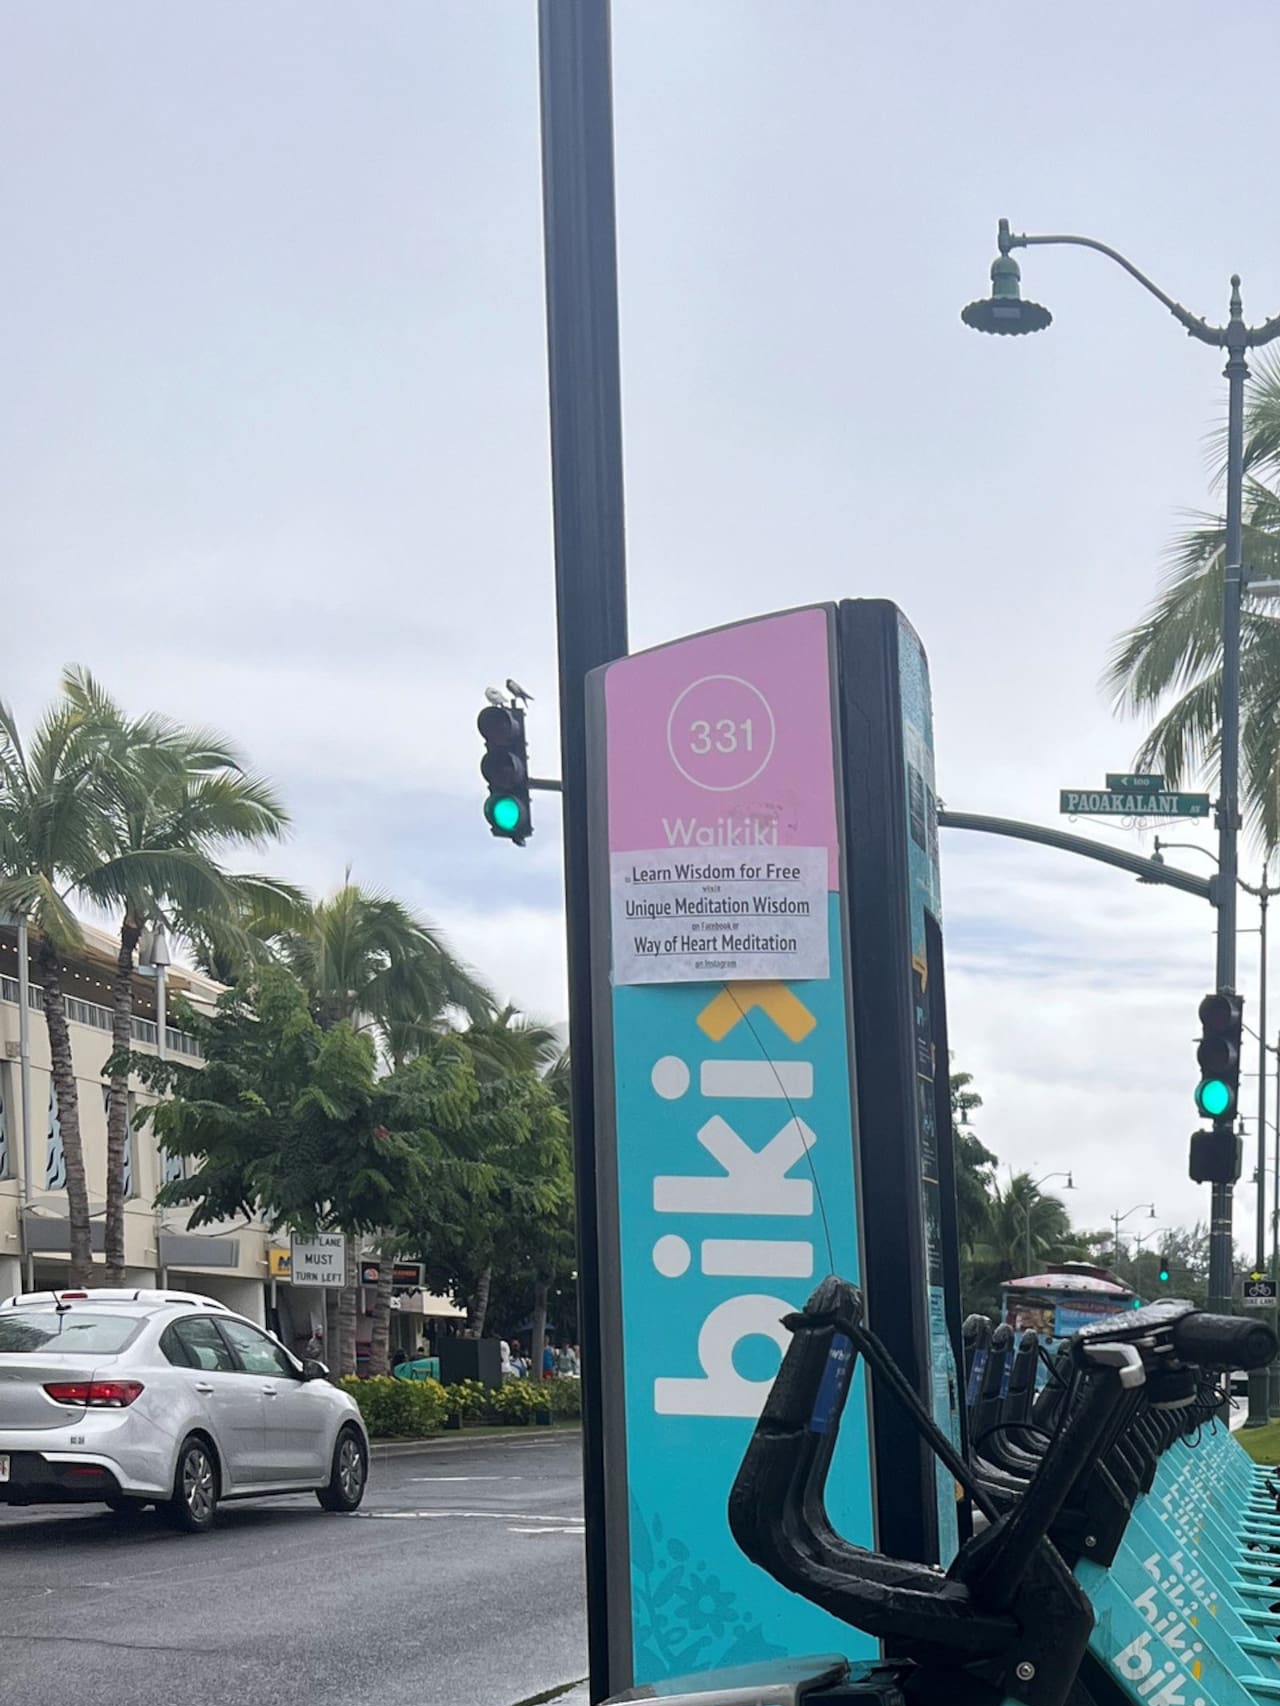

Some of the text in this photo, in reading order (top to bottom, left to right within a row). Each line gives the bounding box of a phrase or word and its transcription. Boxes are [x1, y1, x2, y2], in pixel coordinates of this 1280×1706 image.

[690, 718, 753, 754] 331
[1068, 793, 1179, 814] PAOAKALANI
[661, 817, 779, 847] Waikiki
[633, 864, 801, 882] Learn Wisdom for Free
[625, 897, 810, 920] Unique Meditation Wisdom
[701, 922, 731, 930] Facebook
[634, 935, 797, 957] Way of Heart Meditation
[705, 960, 737, 969] Instagram
[320, 1236, 342, 1247] LANE
[652, 1055, 817, 1418] biki
[304, 1254, 334, 1265] MUST
[296, 1272, 342, 1282] TURN LEFT
